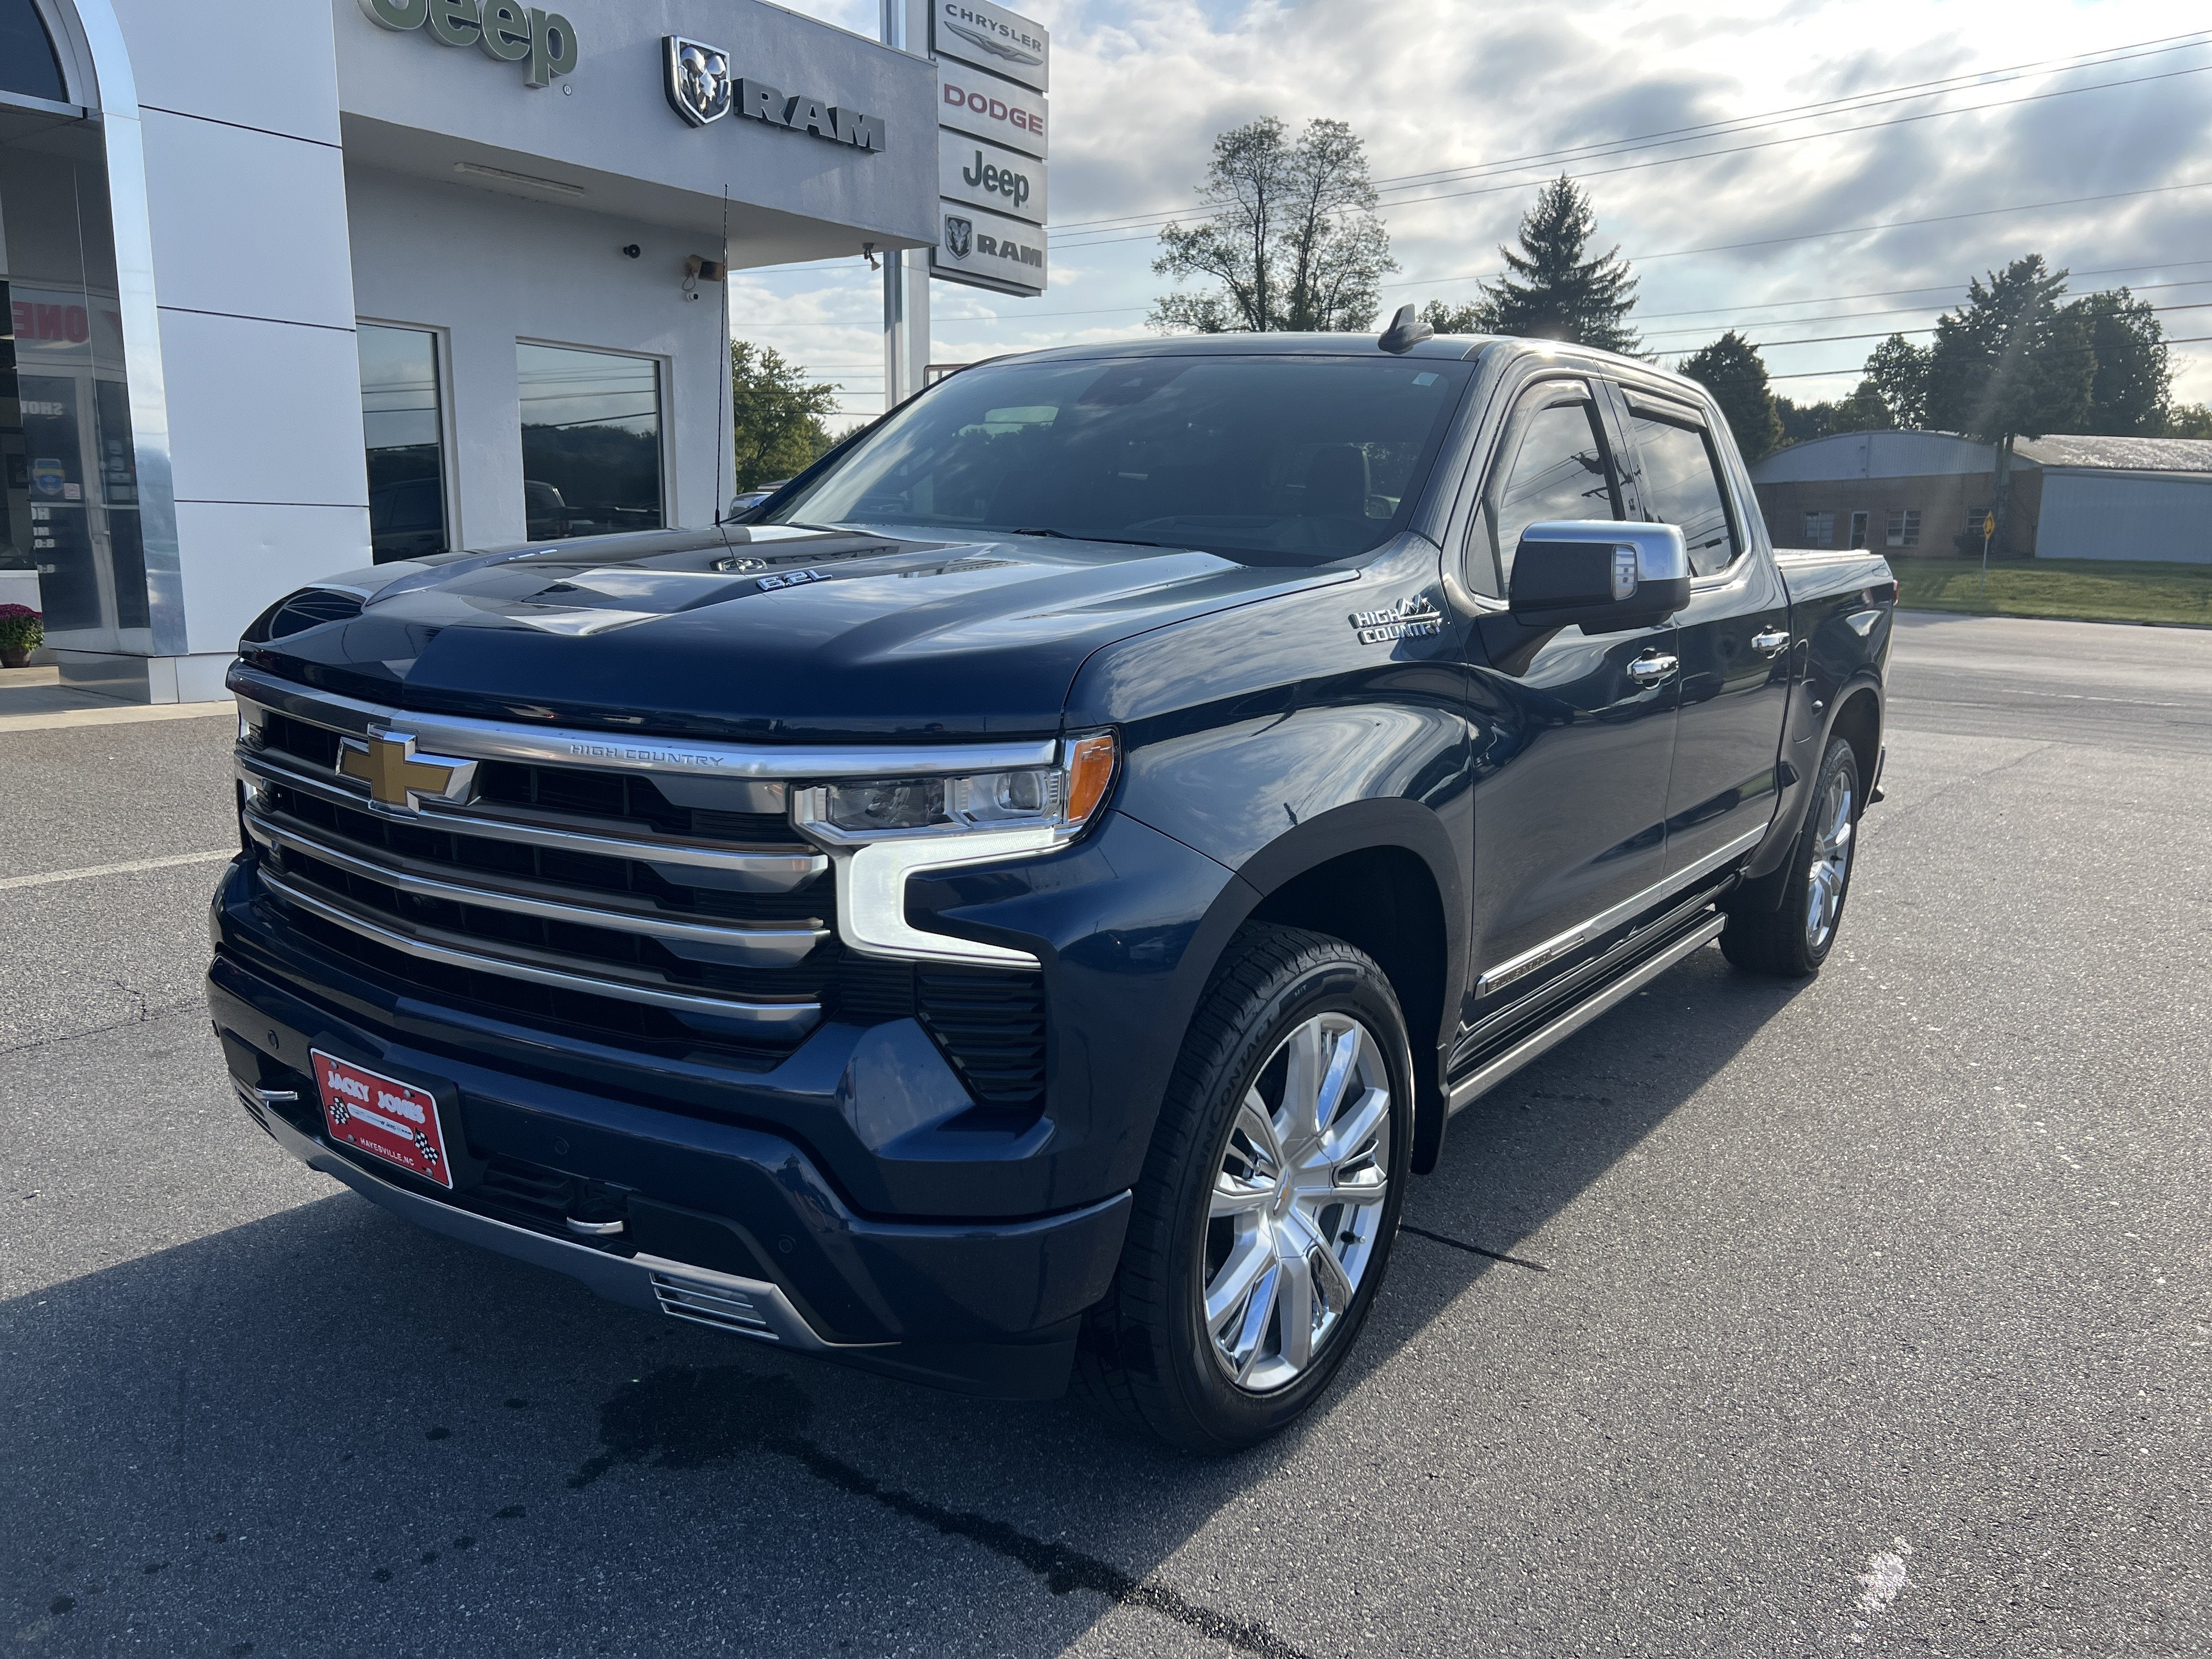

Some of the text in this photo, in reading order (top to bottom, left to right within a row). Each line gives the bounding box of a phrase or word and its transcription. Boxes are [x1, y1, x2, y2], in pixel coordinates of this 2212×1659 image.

[945, 4, 1041, 52] CHRYSLER
[733, 77, 885, 153] RAM
[944, 83, 1043, 137] DODGE
[963, 150, 1029, 208] Jeep
[978, 234, 1042, 268] RAM
[756, 569, 833, 591] 6.2L
[1348, 608, 1400, 629] HIGH
[1357, 618, 1443, 645] COUNTRY
[570, 744, 725, 767] HIGH COUNTRY
[1490, 953, 1548, 991] SILVERADO
[328, 1070, 426, 1124] JACKY JONES
